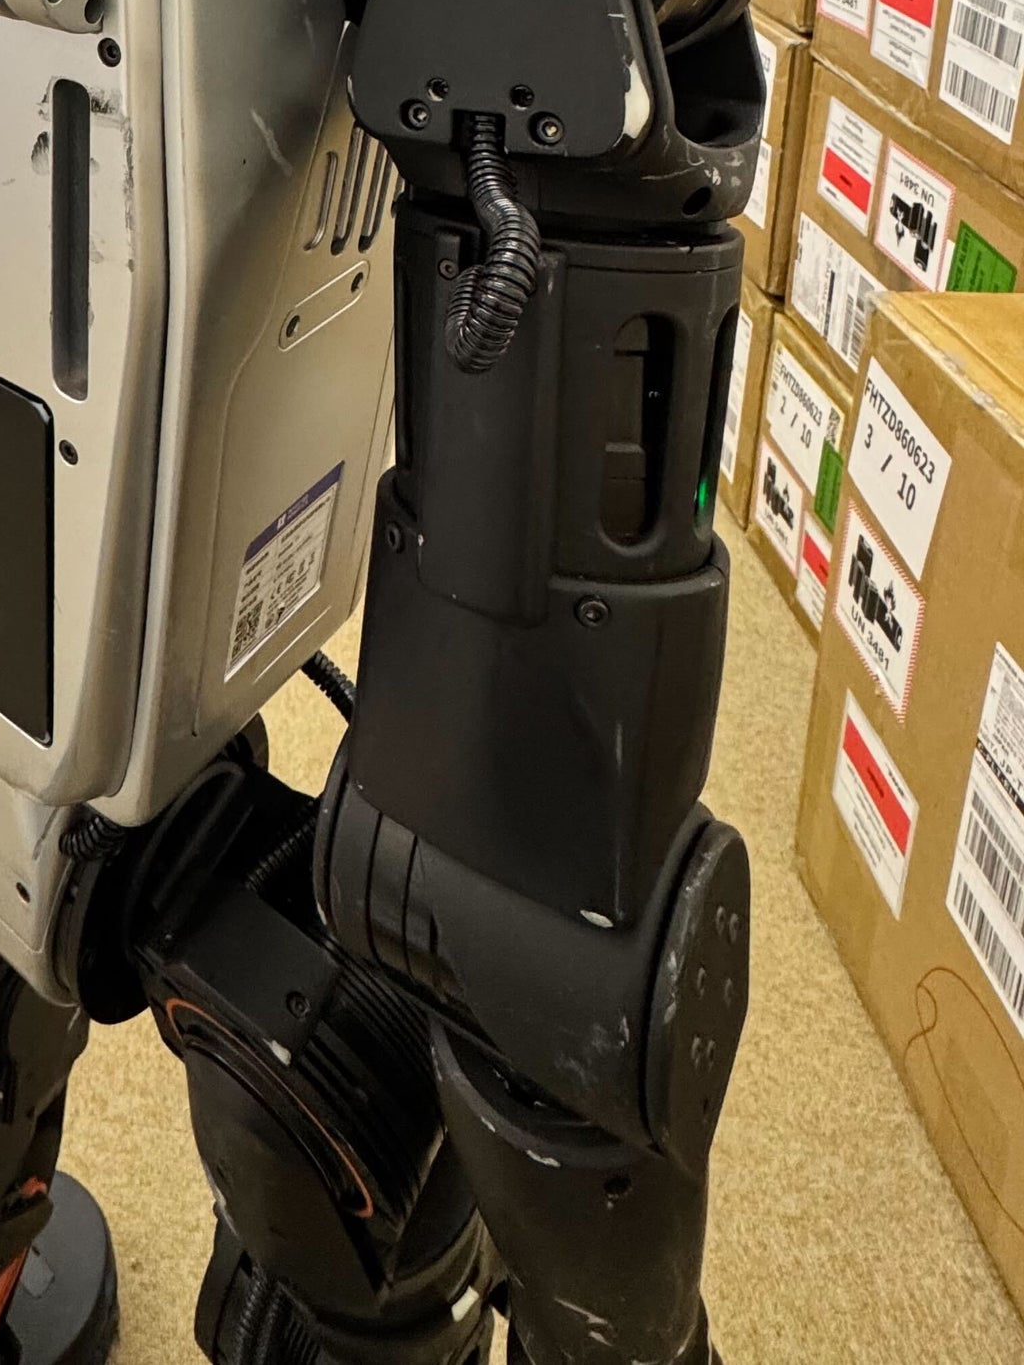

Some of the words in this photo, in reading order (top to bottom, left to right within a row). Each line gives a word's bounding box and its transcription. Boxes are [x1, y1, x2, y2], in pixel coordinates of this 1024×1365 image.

[900, 172, 919, 195] 3481
[921, 188, 934, 207] UN
[800, 424, 812, 449] 10
[864, 378, 935, 484] FHTZD860623
[864, 424, 873, 449] 3
[897, 473, 916, 510] 10
[852, 604, 865, 634] UN
[867, 631, 889, 671] 3481
